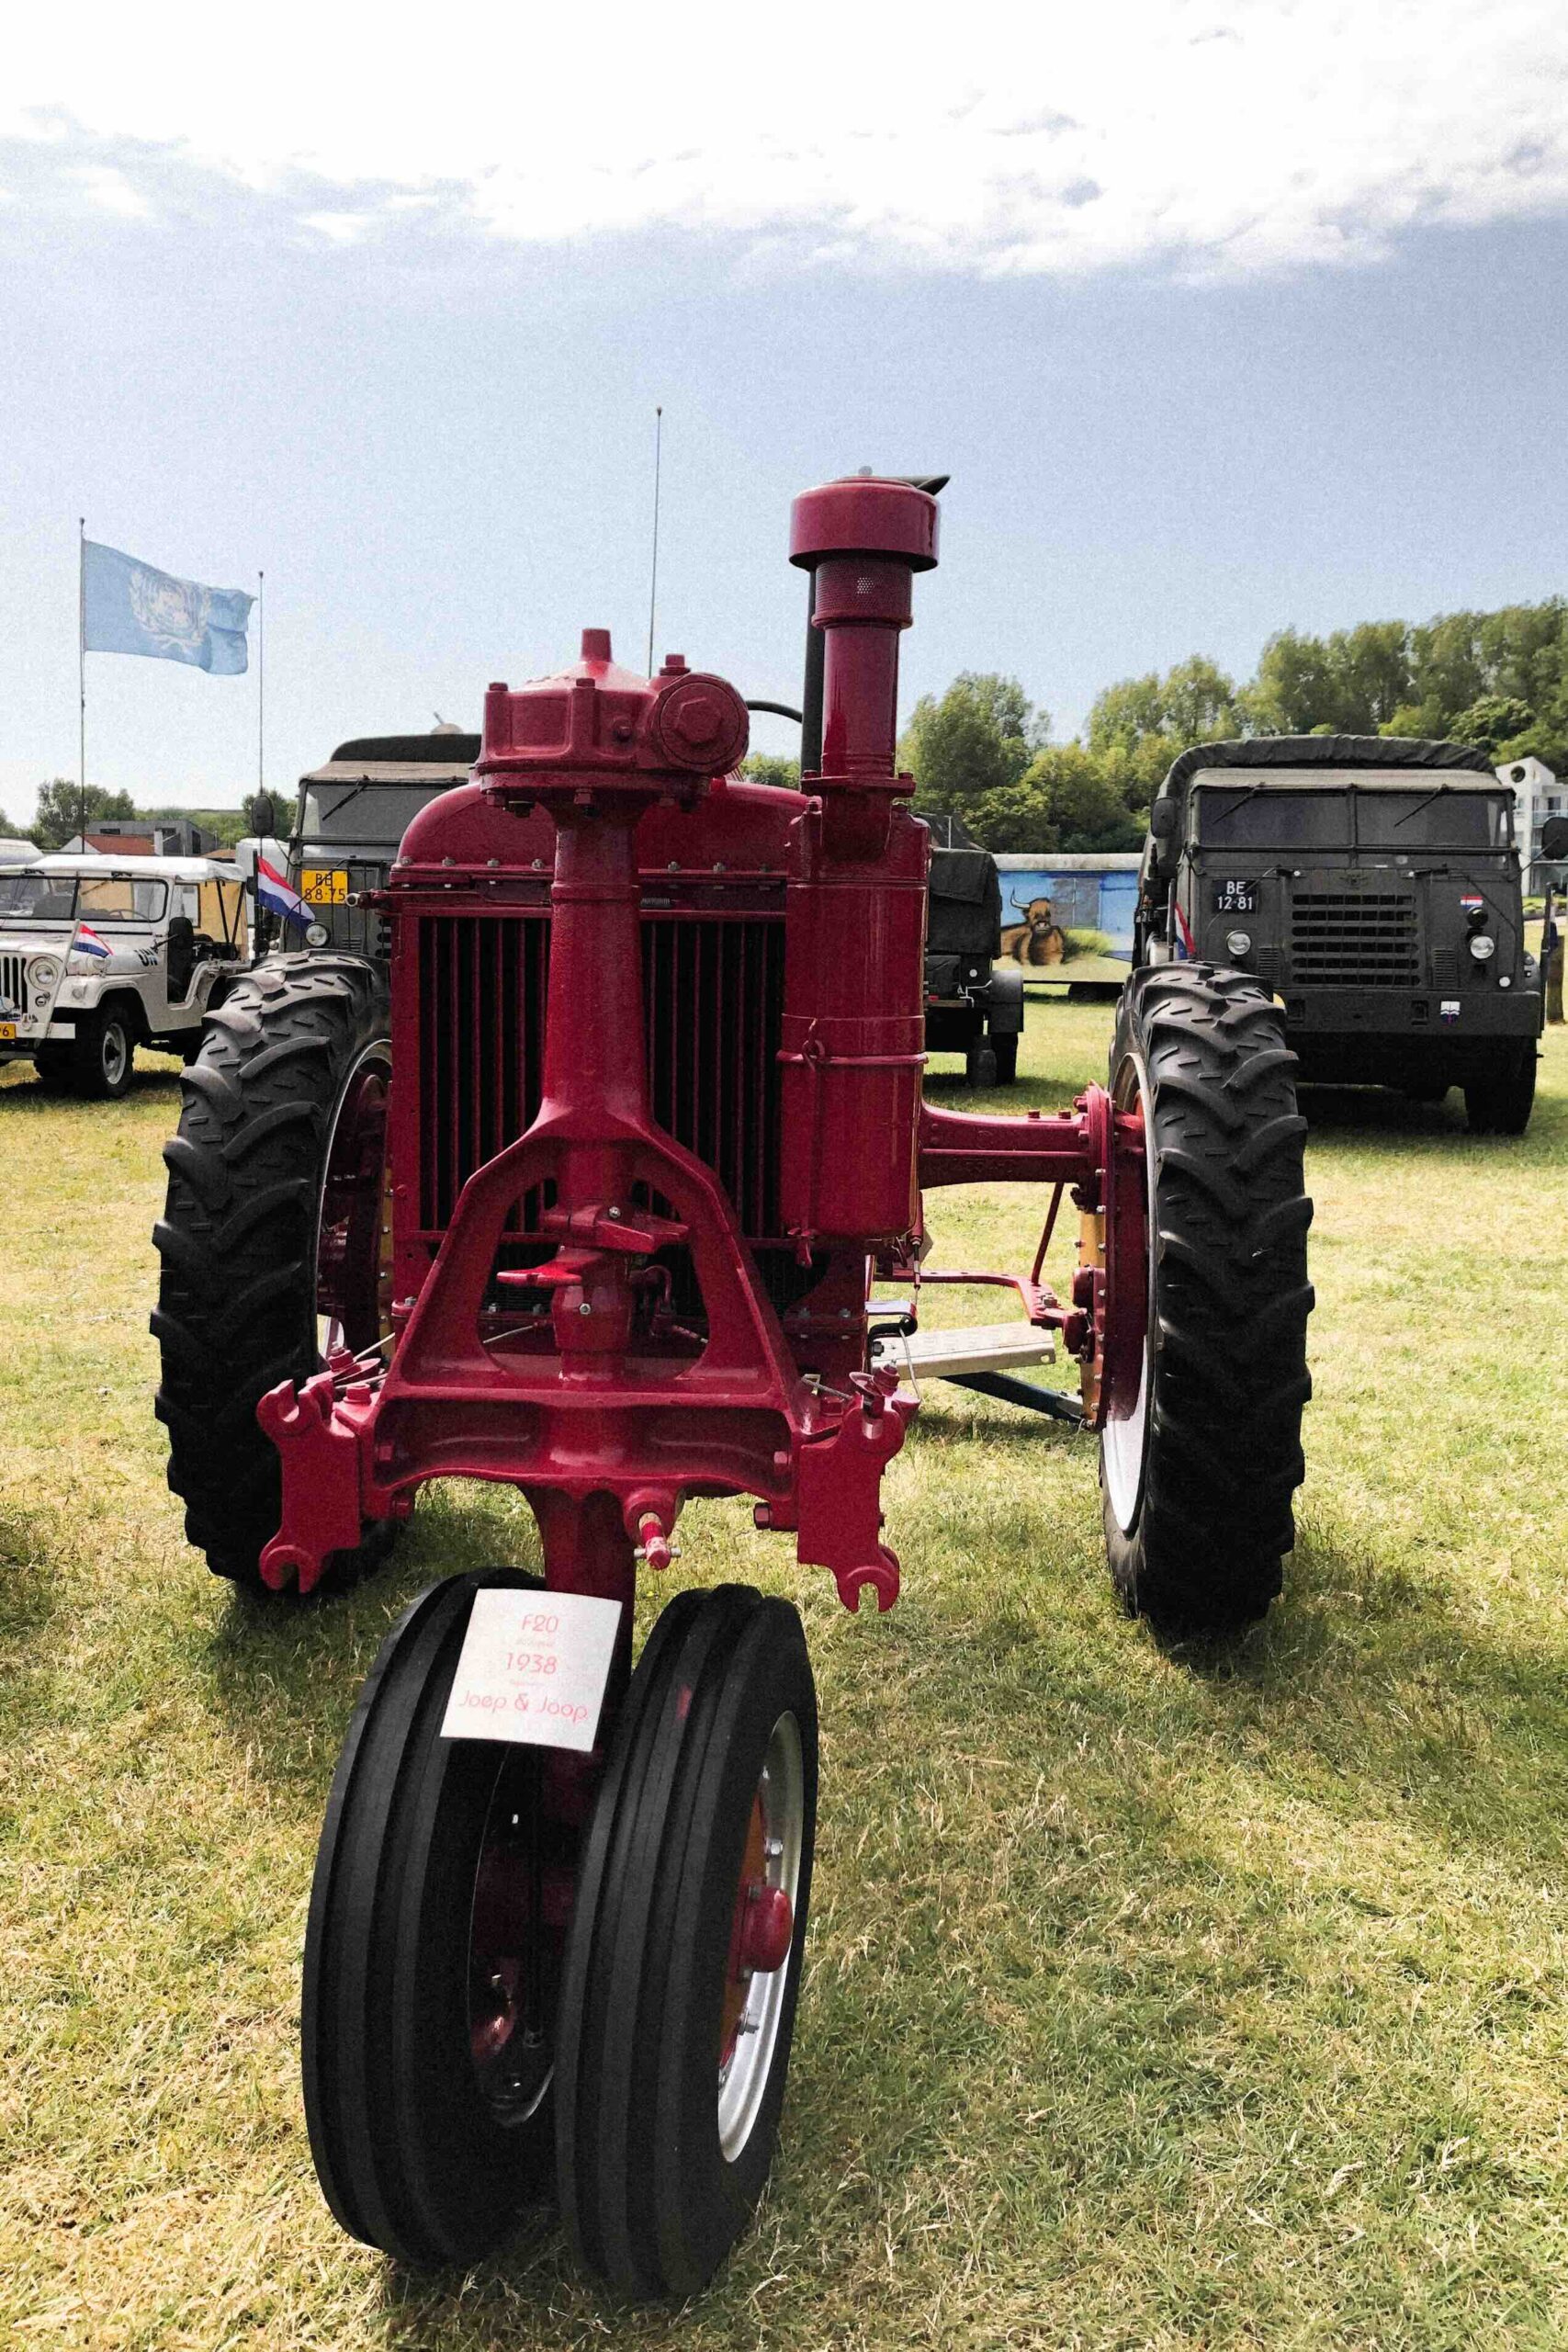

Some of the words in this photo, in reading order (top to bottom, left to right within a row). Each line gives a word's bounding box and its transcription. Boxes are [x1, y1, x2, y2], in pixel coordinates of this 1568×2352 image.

[316, 874, 332, 886] BE
[1226, 880, 1247, 895] BE
[1217, 896, 1253, 910] 12-81
[0, 1025, 9, 1036] 6
[522, 1613, 559, 1633] F20
[506, 1652, 558, 1674] 1938
[458, 1690, 507, 1713] Joep
[514, 1693, 529, 1711] &
[536, 1695, 589, 1723] Joop
